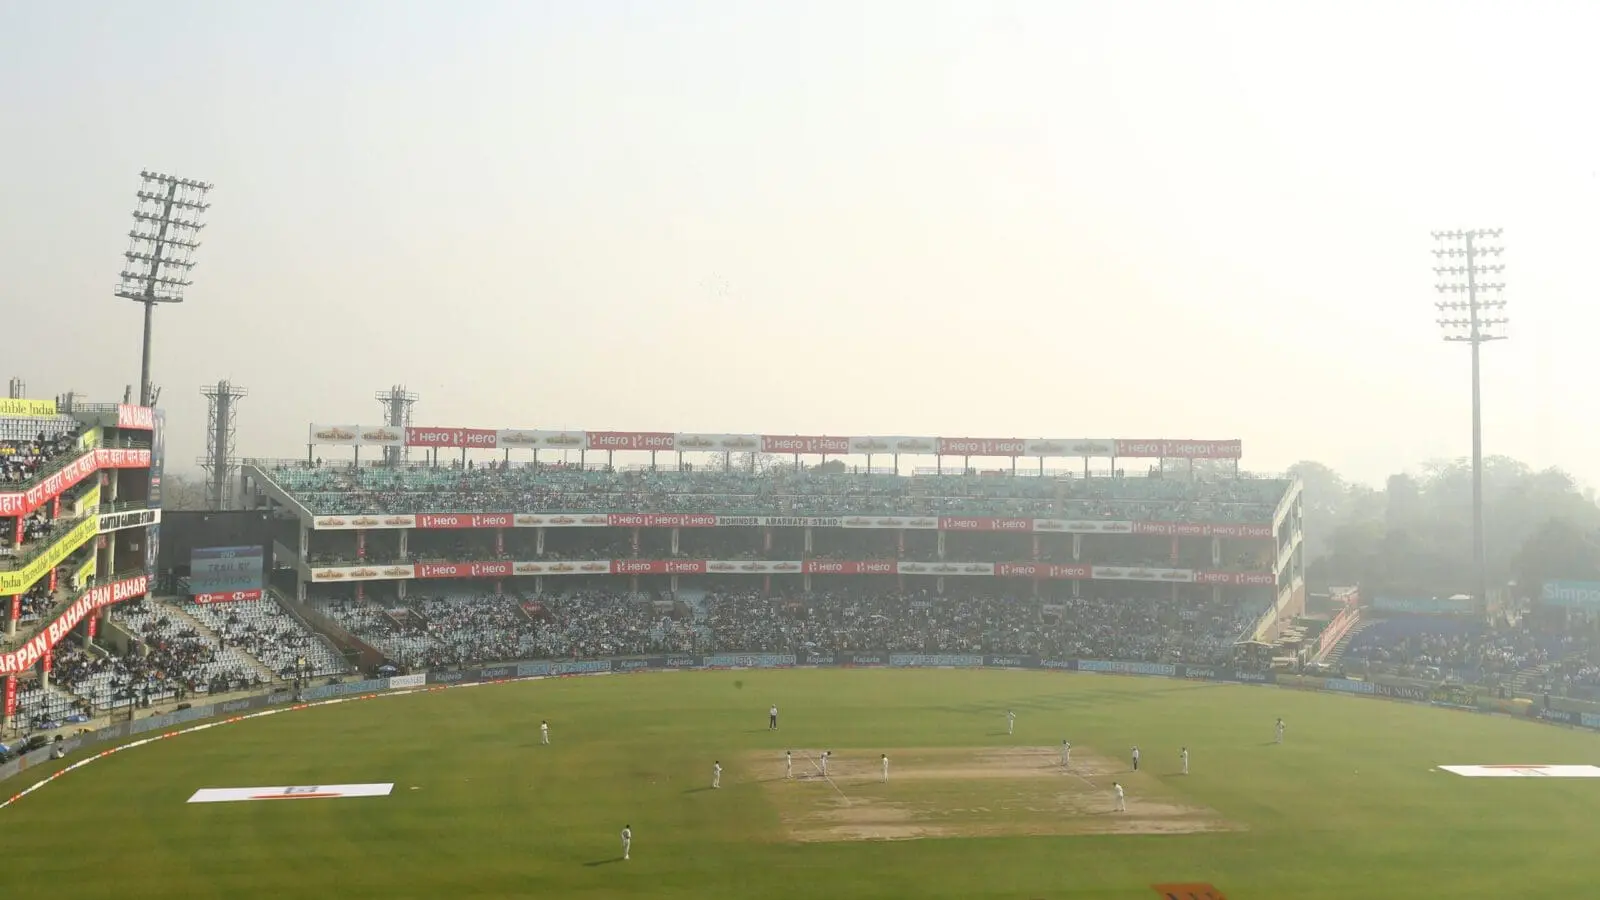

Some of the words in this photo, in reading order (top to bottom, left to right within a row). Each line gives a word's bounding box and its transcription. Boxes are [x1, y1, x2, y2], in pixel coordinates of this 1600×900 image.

[420, 432, 449, 442] Hero
[467, 434, 496, 443] Hero
[600, 436, 628, 445] Hero
[646, 436, 674, 446] Hero
[774, 440, 803, 449] Hero
[820, 440, 848, 449] Hero
[949, 442, 978, 452] Hero
[996, 443, 1024, 452] Hero
[1128, 444, 1158, 453] Hero
[434, 517, 458, 525] Hero
[483, 517, 506, 525] Hero
[692, 517, 715, 525] Hero
[432, 566, 456, 574] Hero
[676, 563, 699, 571] Hero
[1061, 568, 1084, 576] Hero
[17, 633, 46, 671] PAN
[49, 594, 92, 644] BAHAR
[92, 586, 110, 607] PAN
[113, 577, 146, 600] BAHAR
